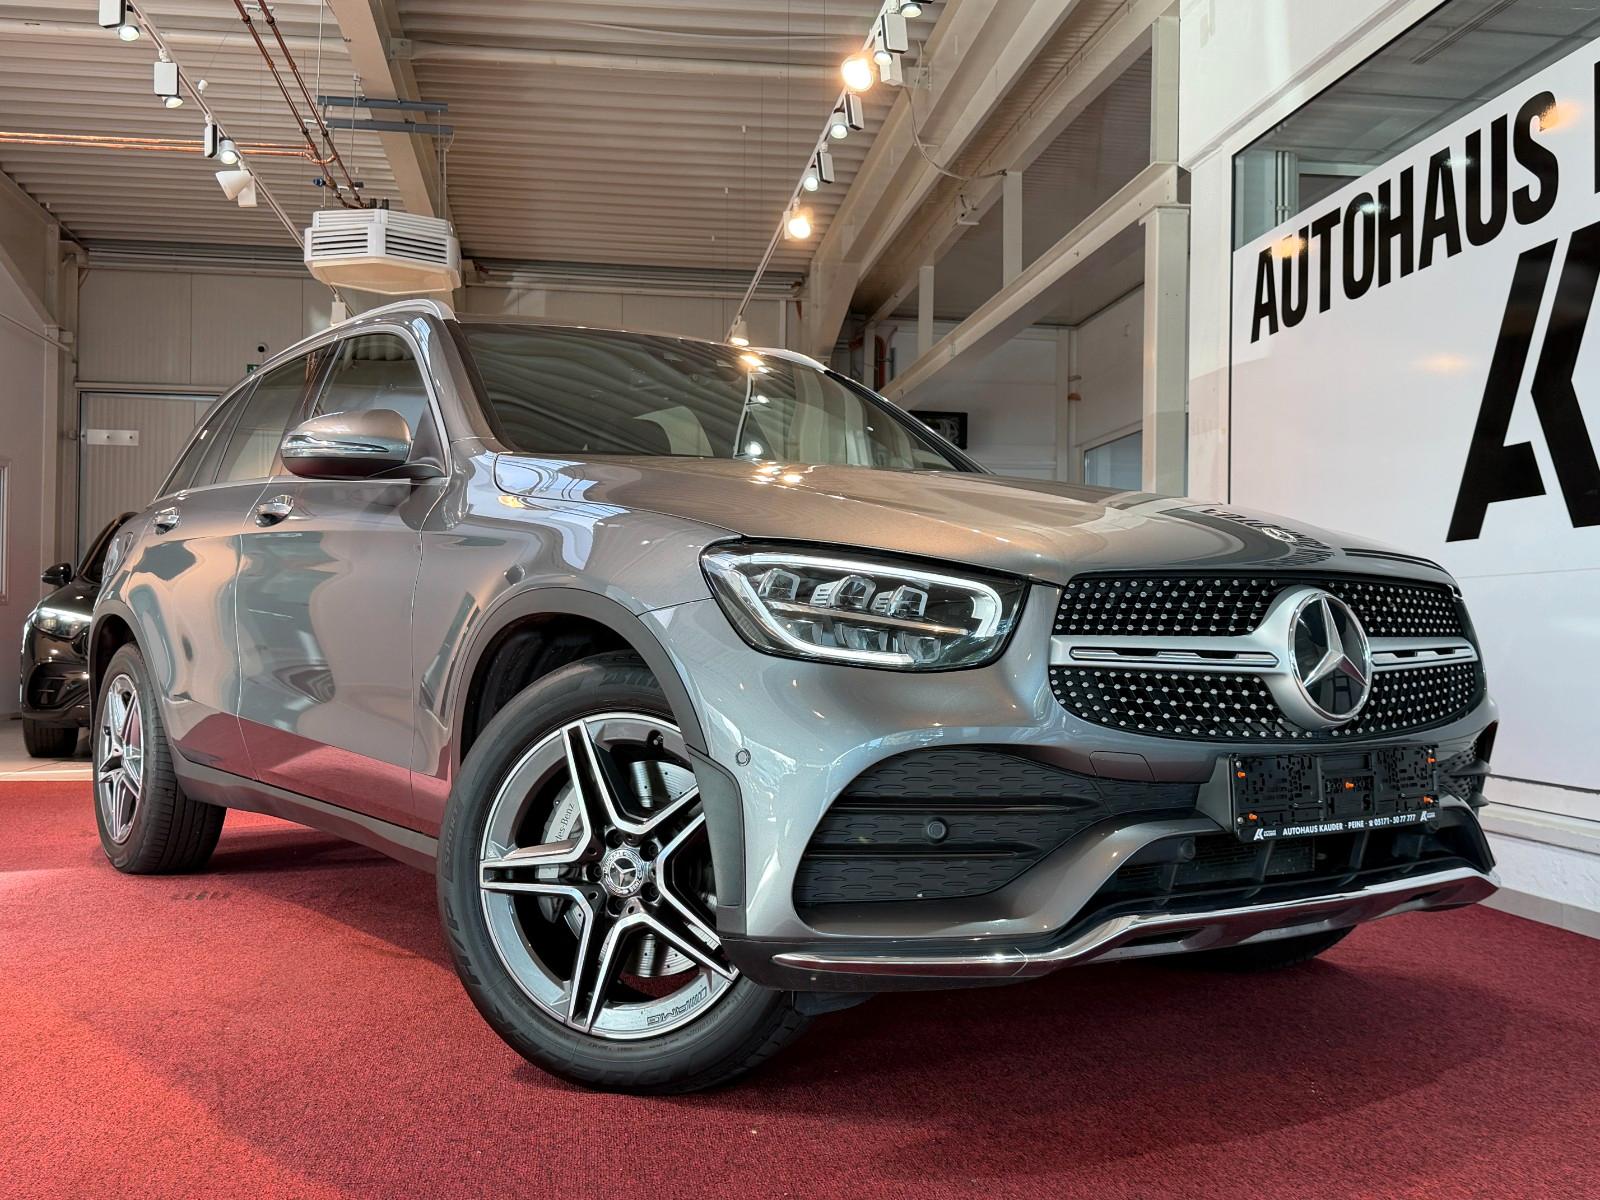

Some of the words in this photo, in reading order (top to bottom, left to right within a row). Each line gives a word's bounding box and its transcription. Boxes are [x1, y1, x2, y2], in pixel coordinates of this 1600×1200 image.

[1250, 91, 1559, 344] AUTOHAUS
[1282, 825, 1318, 836] AUTOHAUS
[1319, 822, 1343, 832] KAUDER
[1348, 820, 1364, 829] PEINE
